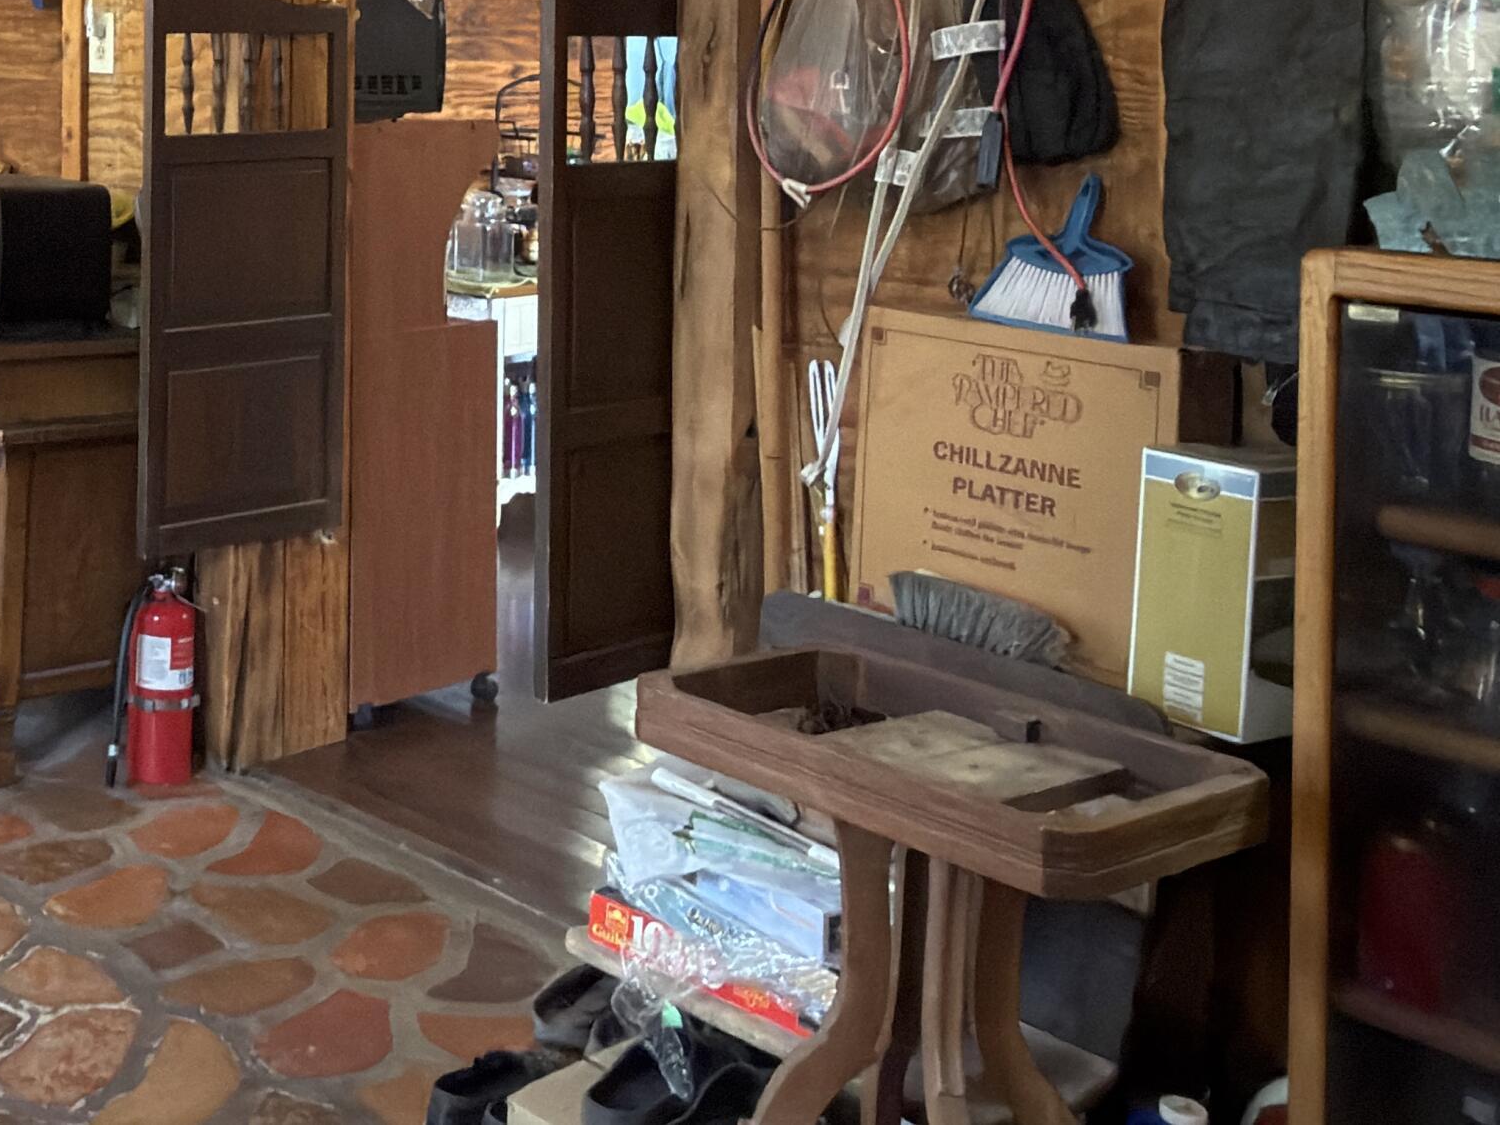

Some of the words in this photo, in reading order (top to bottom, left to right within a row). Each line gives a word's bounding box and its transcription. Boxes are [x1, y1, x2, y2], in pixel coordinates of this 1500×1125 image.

[971, 353, 1024, 385] THE
[952, 373, 1084, 424] PAMPERED
[932, 440, 1082, 489] CHILLZANNE
[952, 477, 1057, 517] PLATTER
